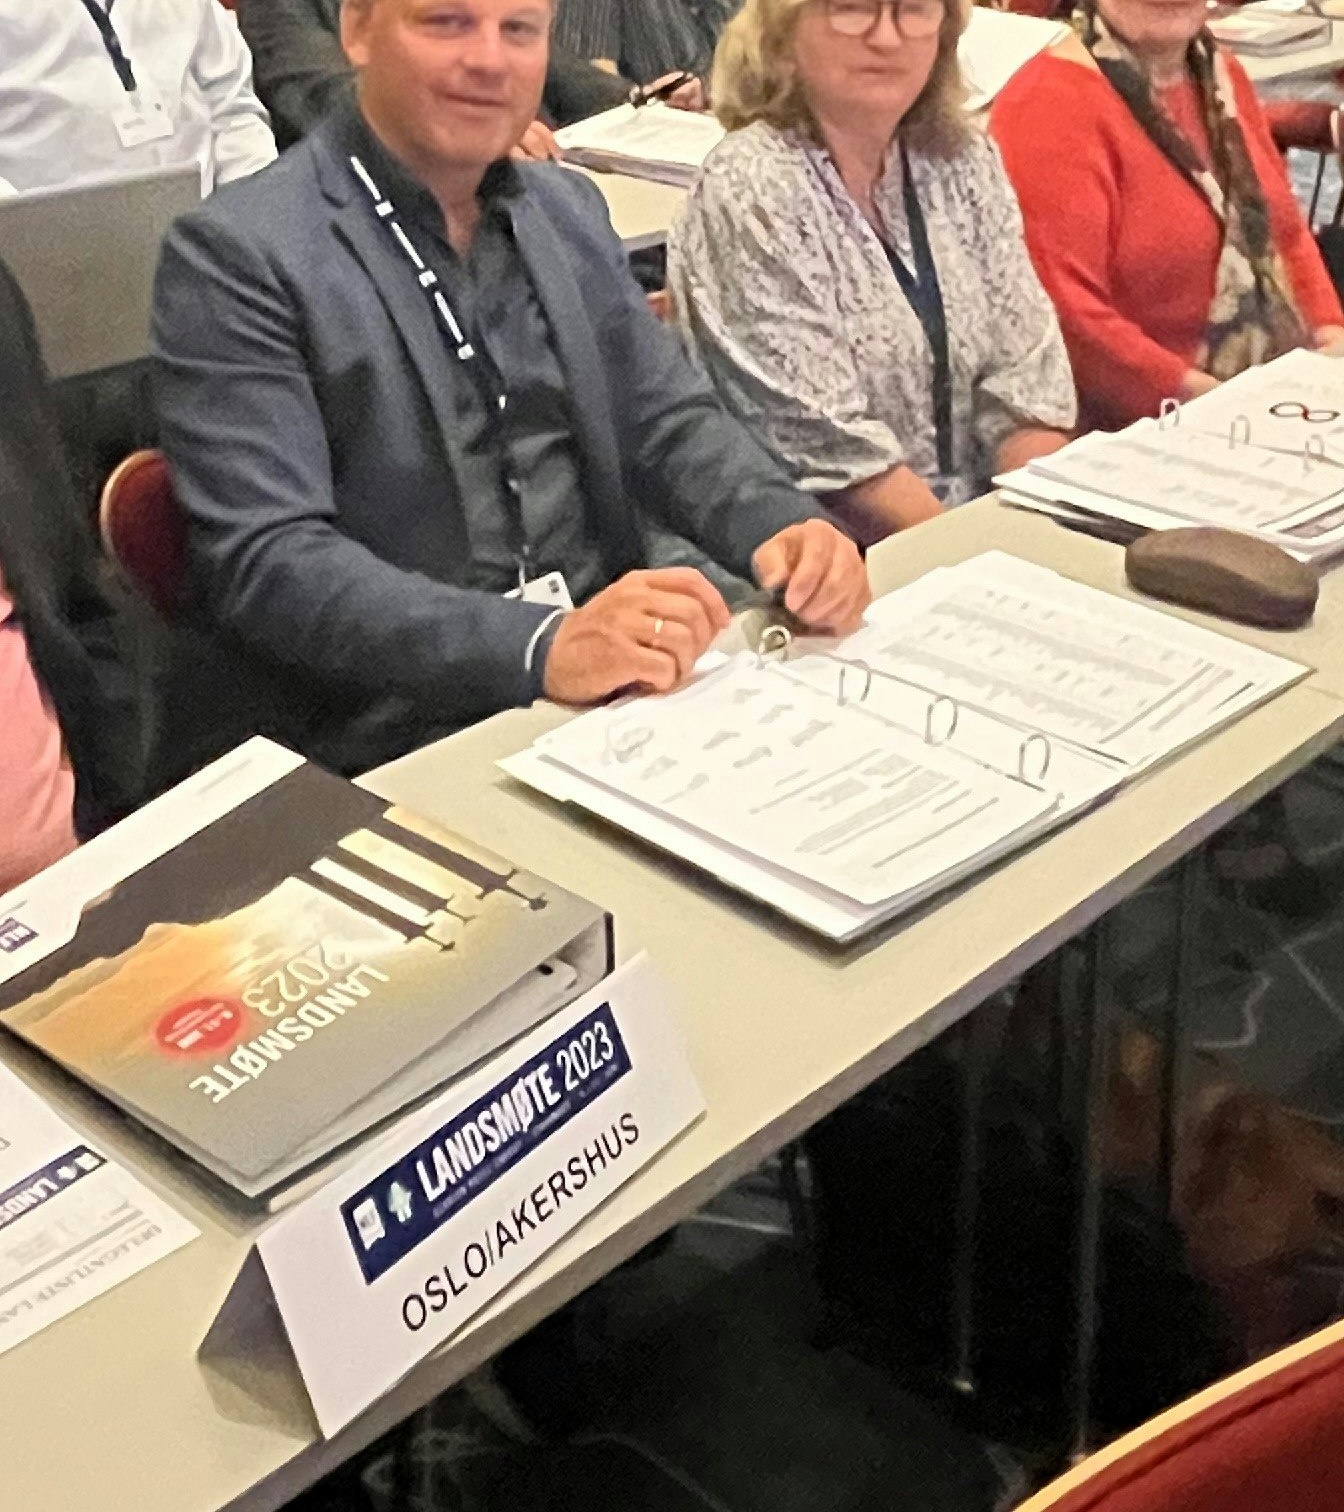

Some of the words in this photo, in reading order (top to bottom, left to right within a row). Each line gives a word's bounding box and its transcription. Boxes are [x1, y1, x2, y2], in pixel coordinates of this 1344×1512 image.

[188, 963, 391, 1105] LANDSMØTE
[241, 936, 353, 1018] 2023
[415, 1062, 562, 1203] LANDSMØTE
[555, 1020, 616, 1092] 2023
[401, 1112, 641, 1332] OSLO/AKERSHUS
